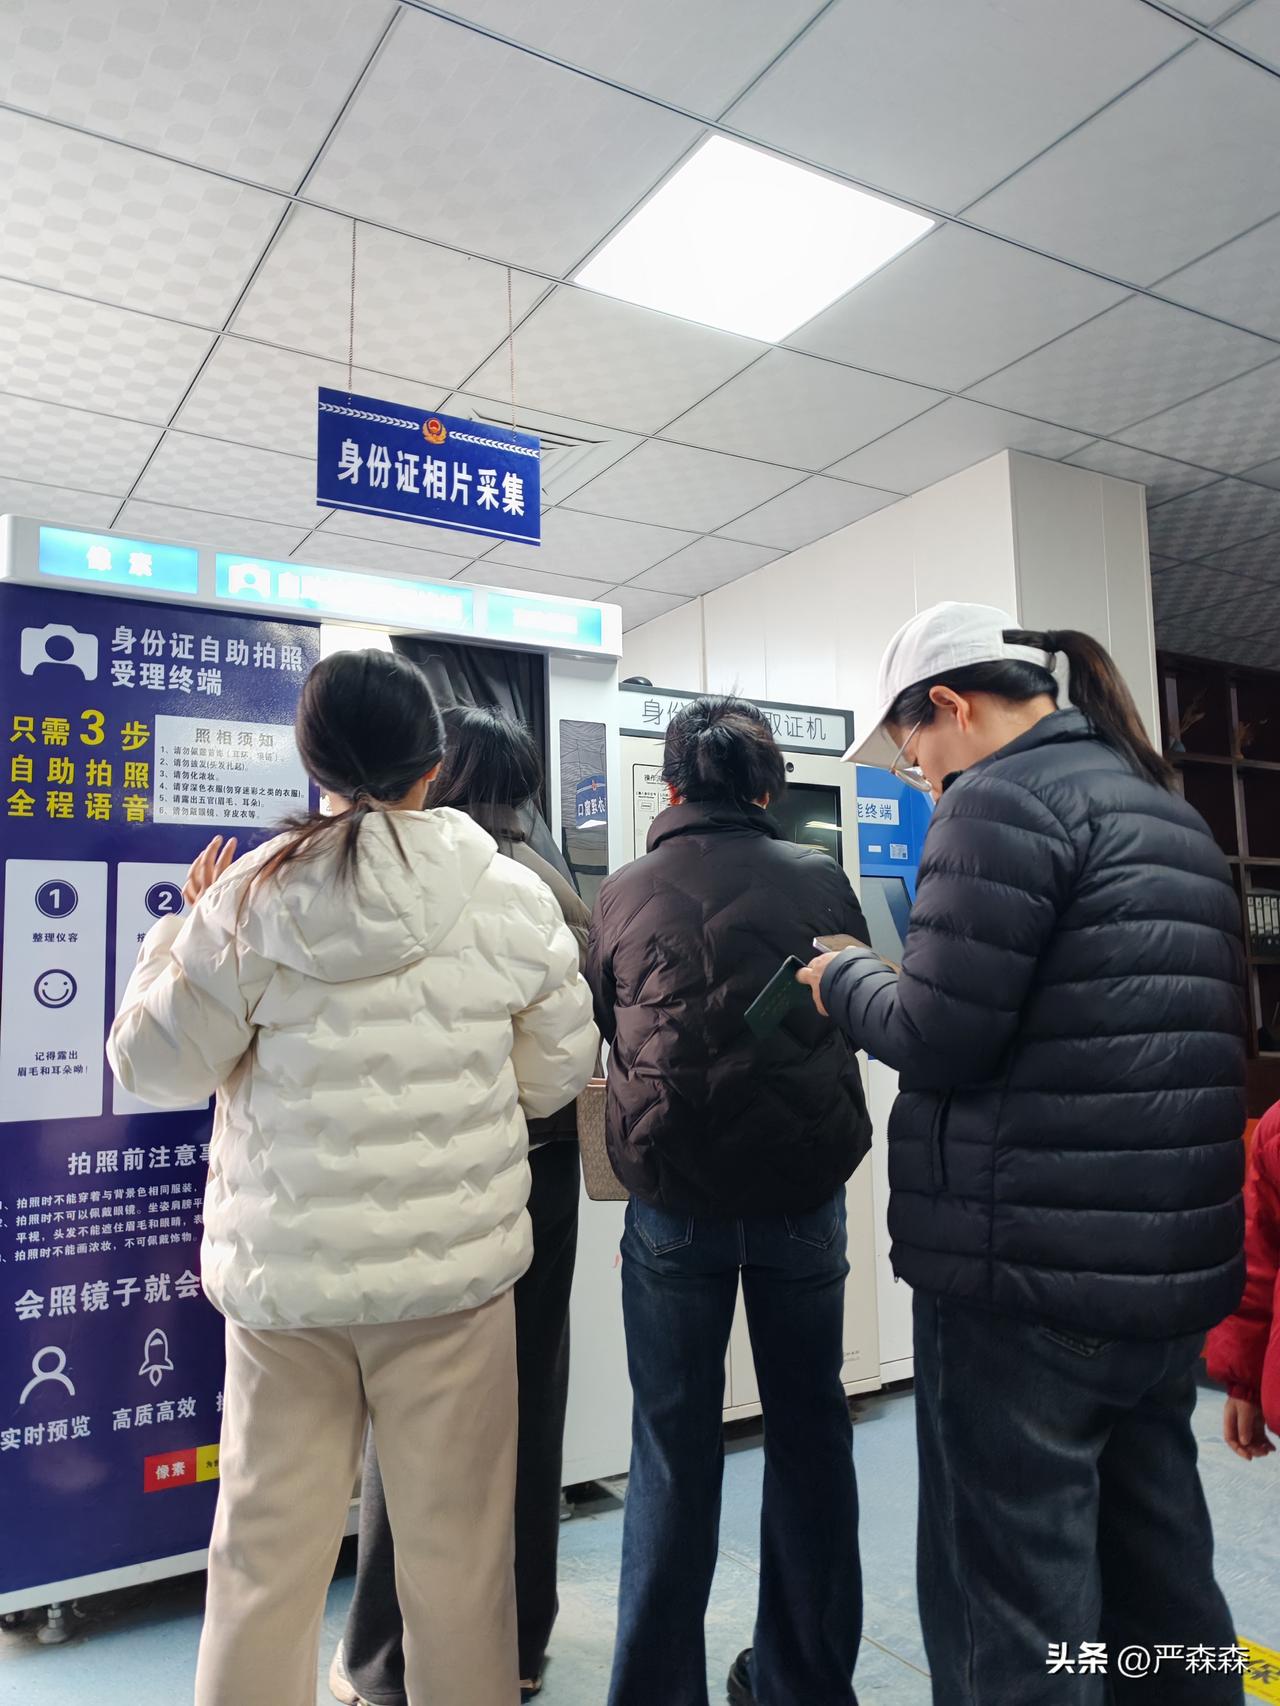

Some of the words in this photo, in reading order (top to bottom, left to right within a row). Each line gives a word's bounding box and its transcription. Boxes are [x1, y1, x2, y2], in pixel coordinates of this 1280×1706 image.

[338, 438, 525, 517] 身份证相片采集
[111, 625, 303, 672] 身份证自助拍照
[110, 659, 223, 697] 受理终端
[195, 728, 274, 747] 照相须知
[9, 753, 150, 789] 自助拍照
[7, 788, 149, 823] 全程语音
[49, 889, 60, 909] 1
[158, 892, 172, 911] 2
[32, 932, 79, 943] 整理仪容
[35, 1051, 78, 1062] 记得露出
[0, 1232, 197, 1263] 、拍照时不能画浓妆，不可佩戴饰物。
[14, 1269, 200, 1320] 会照镜子就会
[112, 1396, 196, 1431] 高质高效
[0, 1415, 91, 1451] 实时预览
[155, 1460, 186, 1480] 像素
